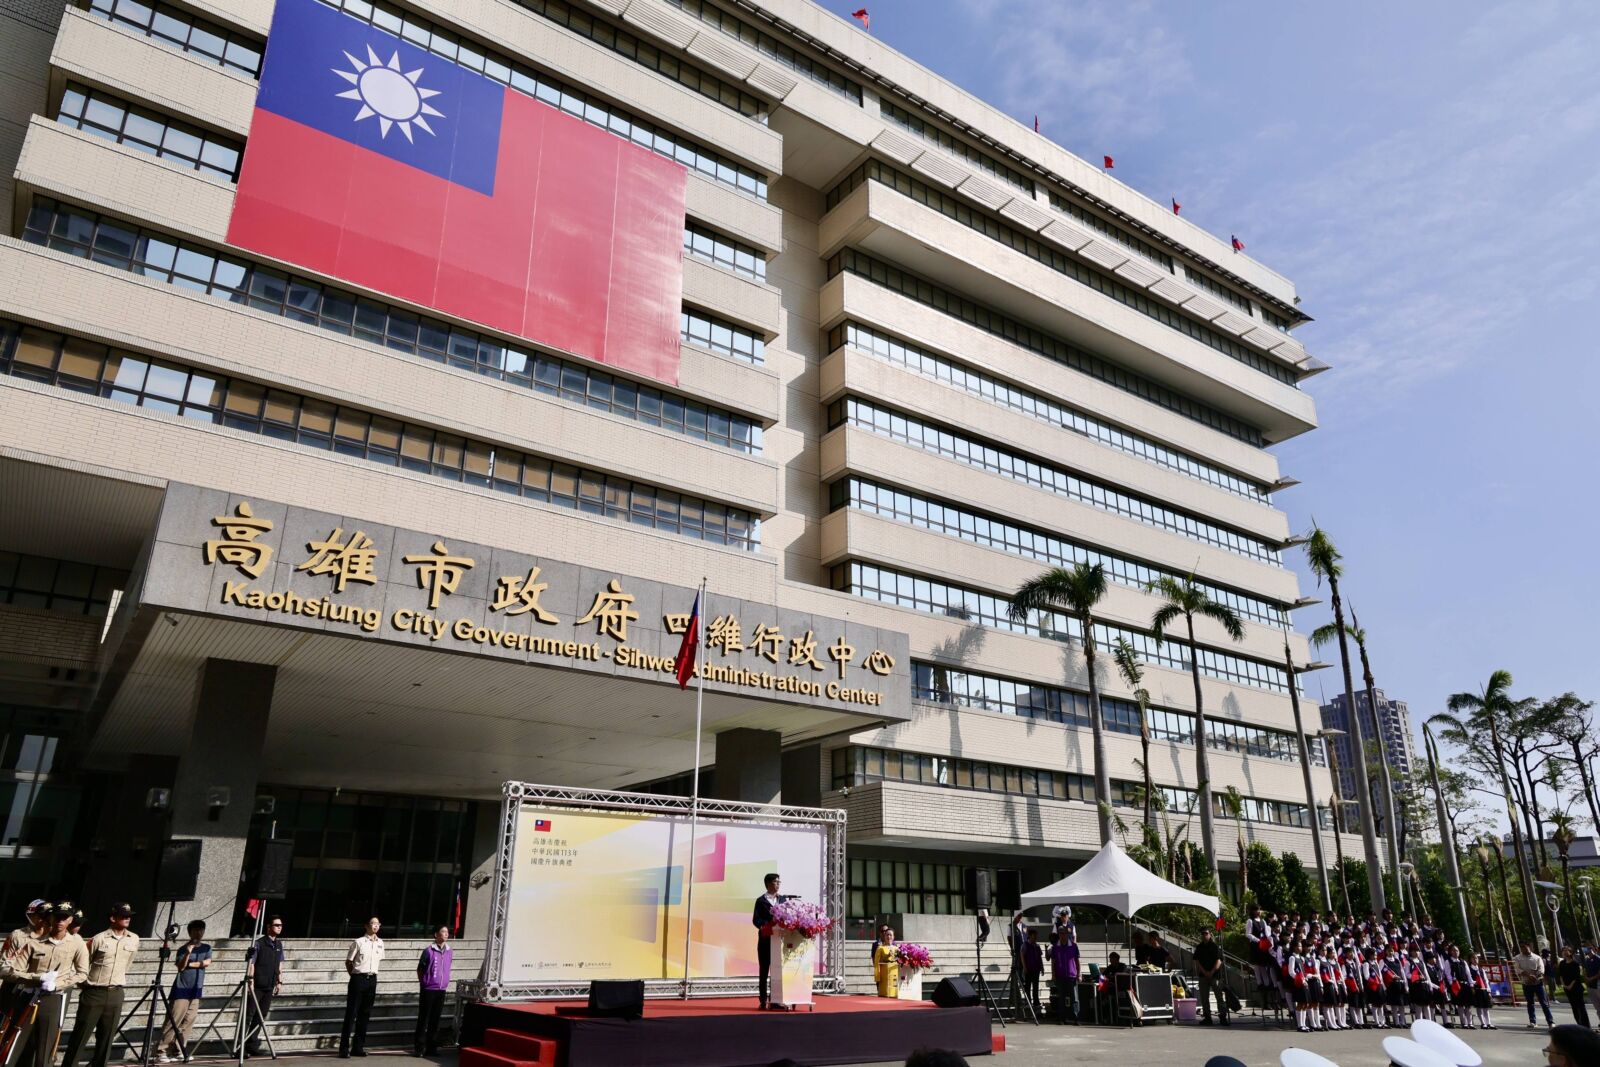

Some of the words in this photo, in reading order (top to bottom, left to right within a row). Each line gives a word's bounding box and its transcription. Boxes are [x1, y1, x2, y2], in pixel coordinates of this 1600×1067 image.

[206, 501, 639, 641] 高雄市政府
[664, 612, 896, 678] 四維行政中心
[224, 581, 382, 632] Kaohsiung
[393, 607, 449, 640] City
[455, 617, 600, 661] Government
[616, 644, 679, 673] Sihwe
[826, 681, 884, 706] Center
